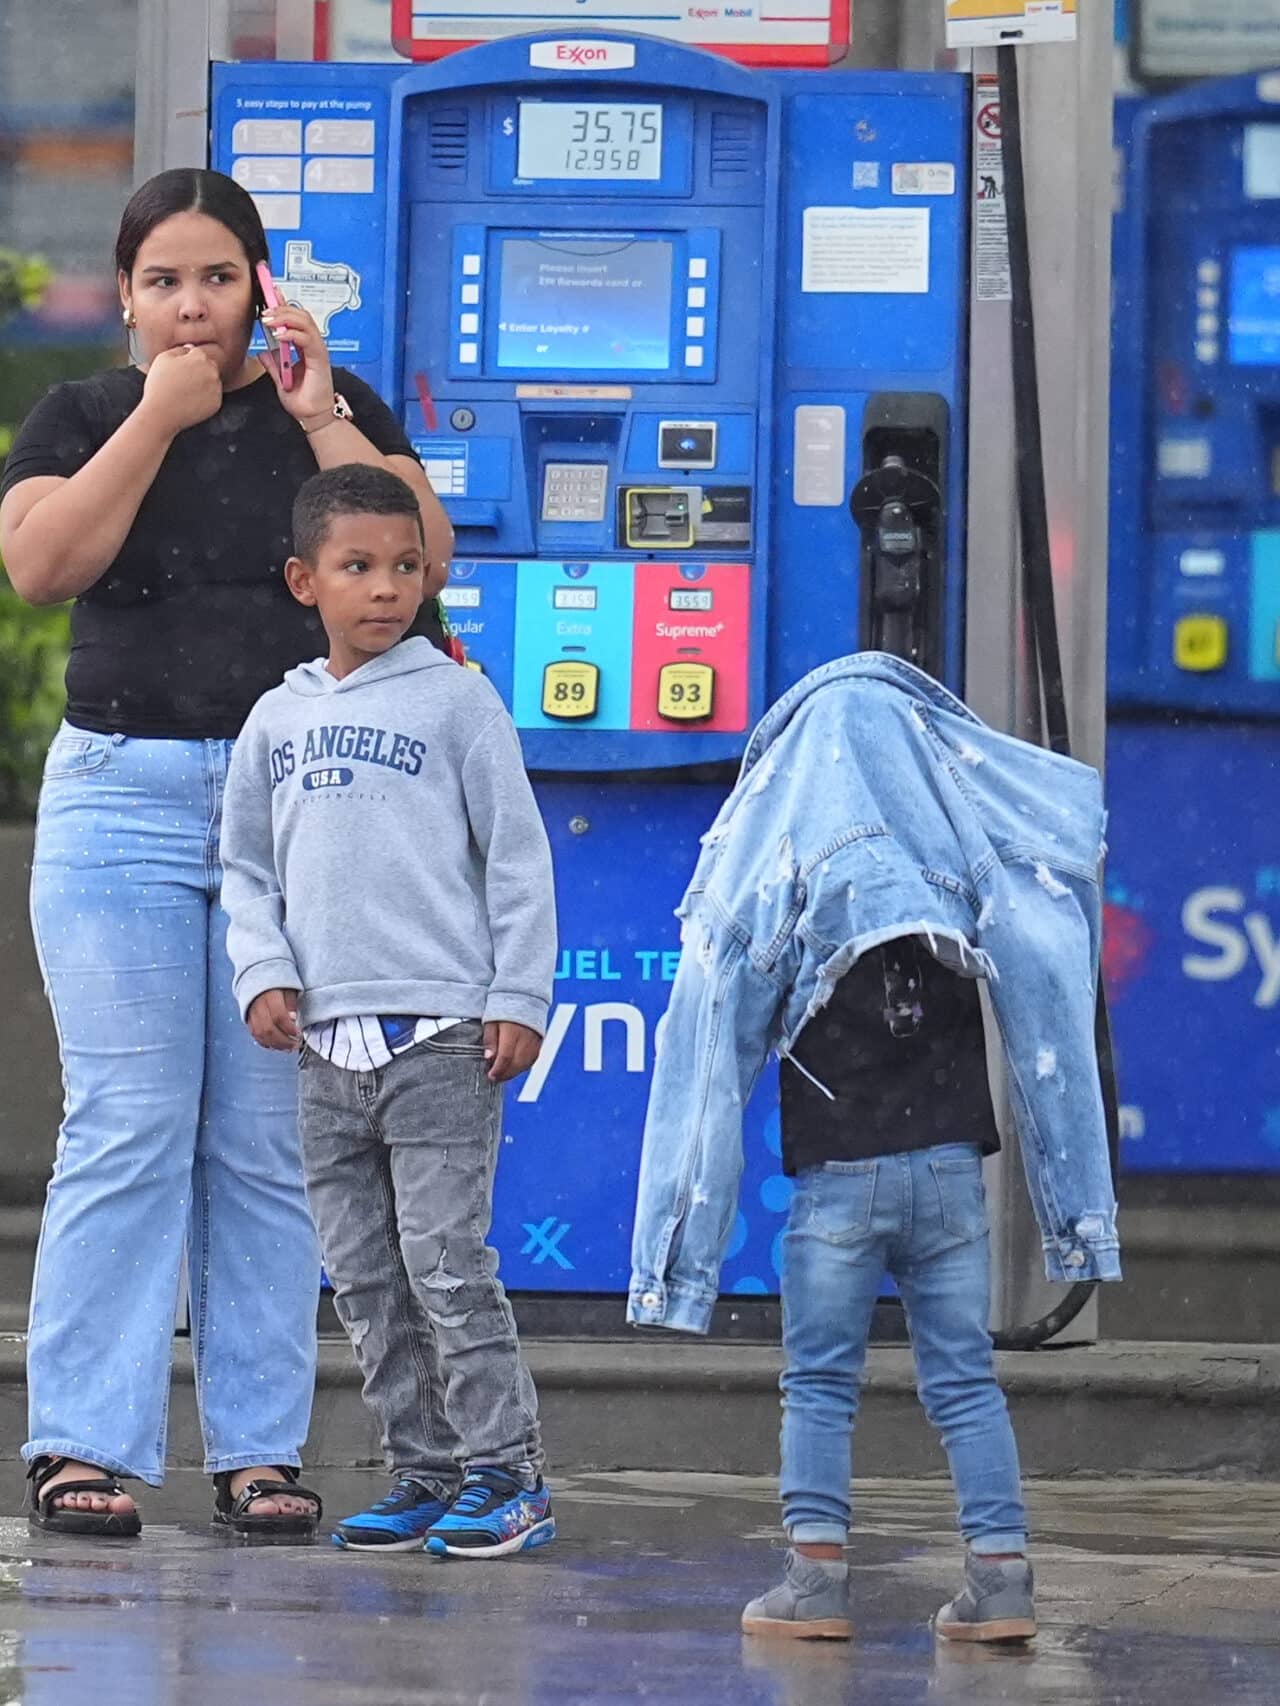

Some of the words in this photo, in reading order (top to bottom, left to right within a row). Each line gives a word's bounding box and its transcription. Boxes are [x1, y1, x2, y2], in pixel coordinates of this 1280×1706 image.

[688, 8, 718, 19] Exxon
[724, 8, 753, 17] Mobil
[556, 45, 607, 65] Exxon
[236, 99, 243, 108] 5
[244, 101, 263, 110] easy
[265, 101, 289, 110] steps
[290, 100, 300, 109] to
[301, 102, 318, 112] pay
[319, 101, 329, 110] at
[330, 100, 344, 110] the
[345, 102, 372, 112] pump
[503, 117, 514, 136] $
[571, 110, 657, 144] 35.75
[565, 150, 641, 171] 12.958
[539, 263, 575, 273] Please
[577, 264, 608, 273] insert
[509, 323, 538, 333] Enter
[540, 324, 579, 336] Loyalty
[442, 620, 484, 636] gular
[557, 623, 592, 635] Extra
[554, 682, 585, 701] 89
[670, 683, 701, 702] 93
[302, 725, 426, 777] ANGELES
[310, 770, 341, 788] USA
[554, 949, 621, 980] UEL
